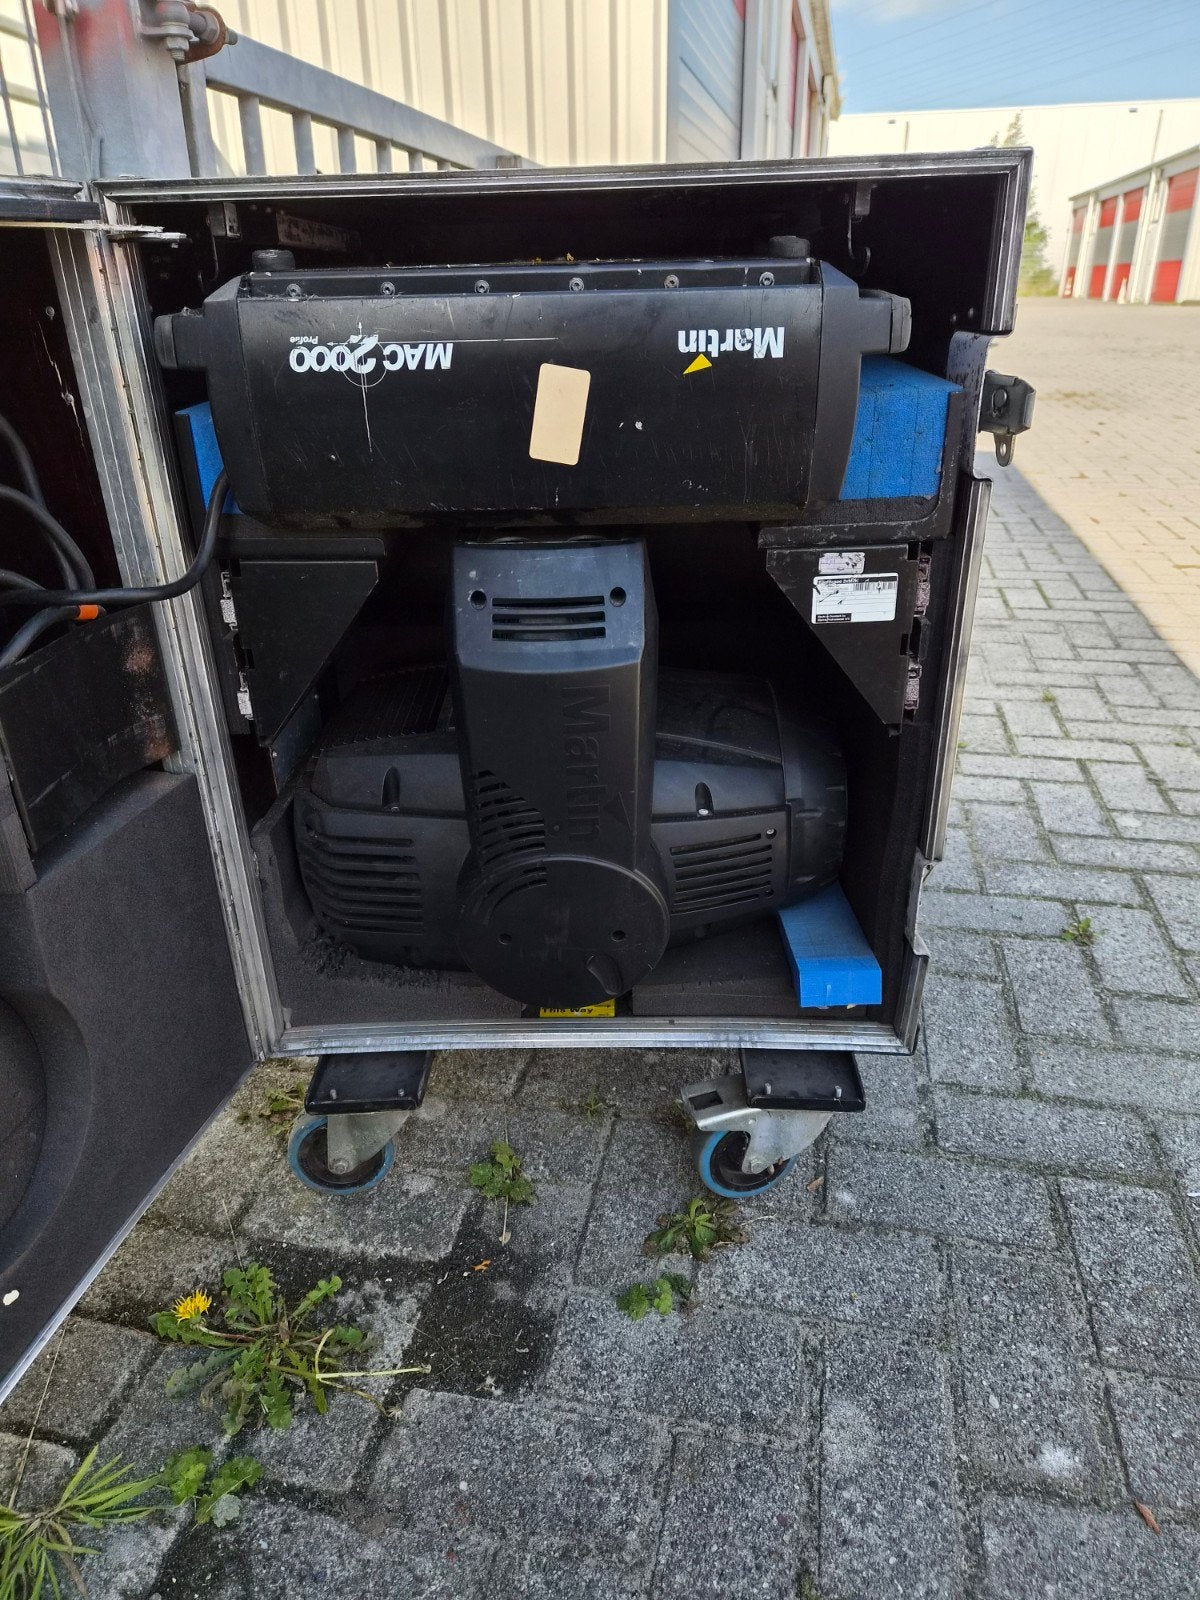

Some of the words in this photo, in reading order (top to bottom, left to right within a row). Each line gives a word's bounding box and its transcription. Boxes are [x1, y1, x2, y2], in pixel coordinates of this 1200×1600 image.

[289, 334, 379, 374] 2000
[382, 343, 454, 371] MAC
[678, 326, 785, 359] Martin
[561, 683, 611, 841] Martin
